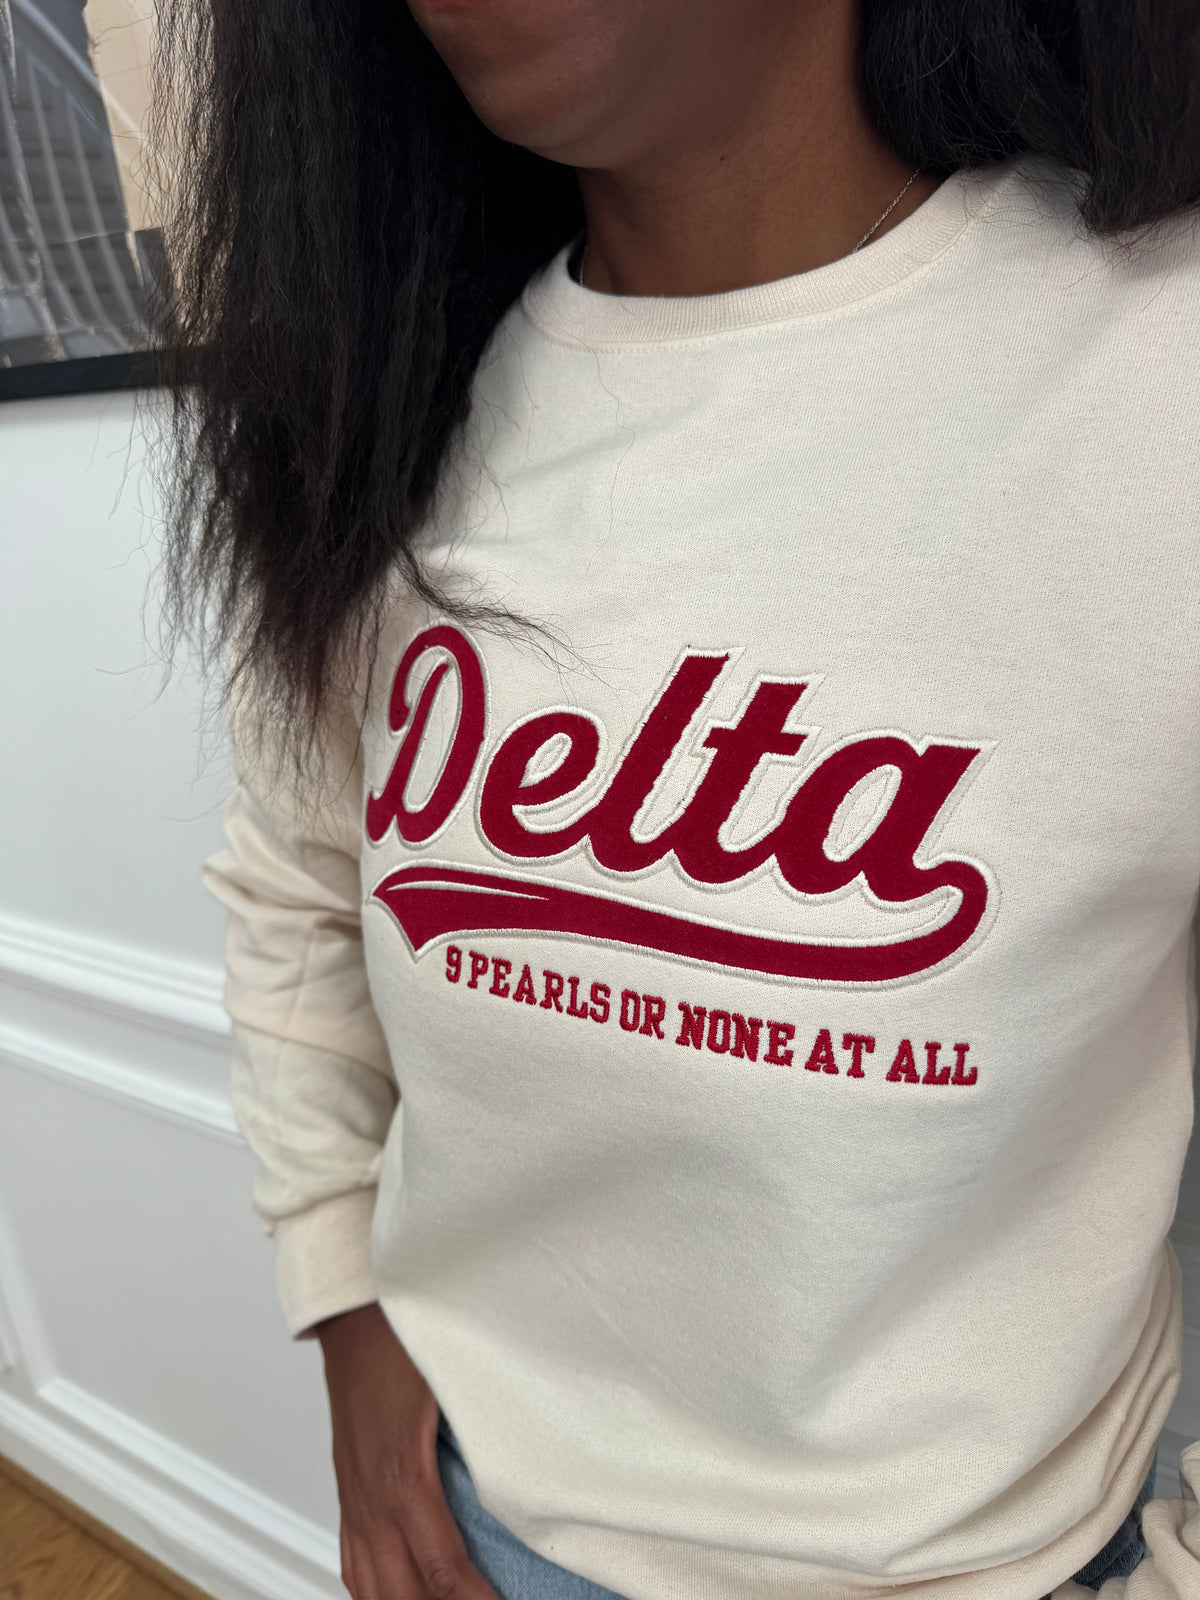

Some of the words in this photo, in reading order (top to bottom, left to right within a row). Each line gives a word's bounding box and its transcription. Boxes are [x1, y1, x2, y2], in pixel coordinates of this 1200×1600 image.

[366, 626, 988, 908] Delta
[445, 945, 462, 984] 9
[466, 950, 611, 1024] PEARLS
[619, 989, 666, 1040] OR
[675, 1001, 796, 1067] NONE
[804, 1028, 876, 1079] AT
[885, 1039, 978, 1086] ALL
